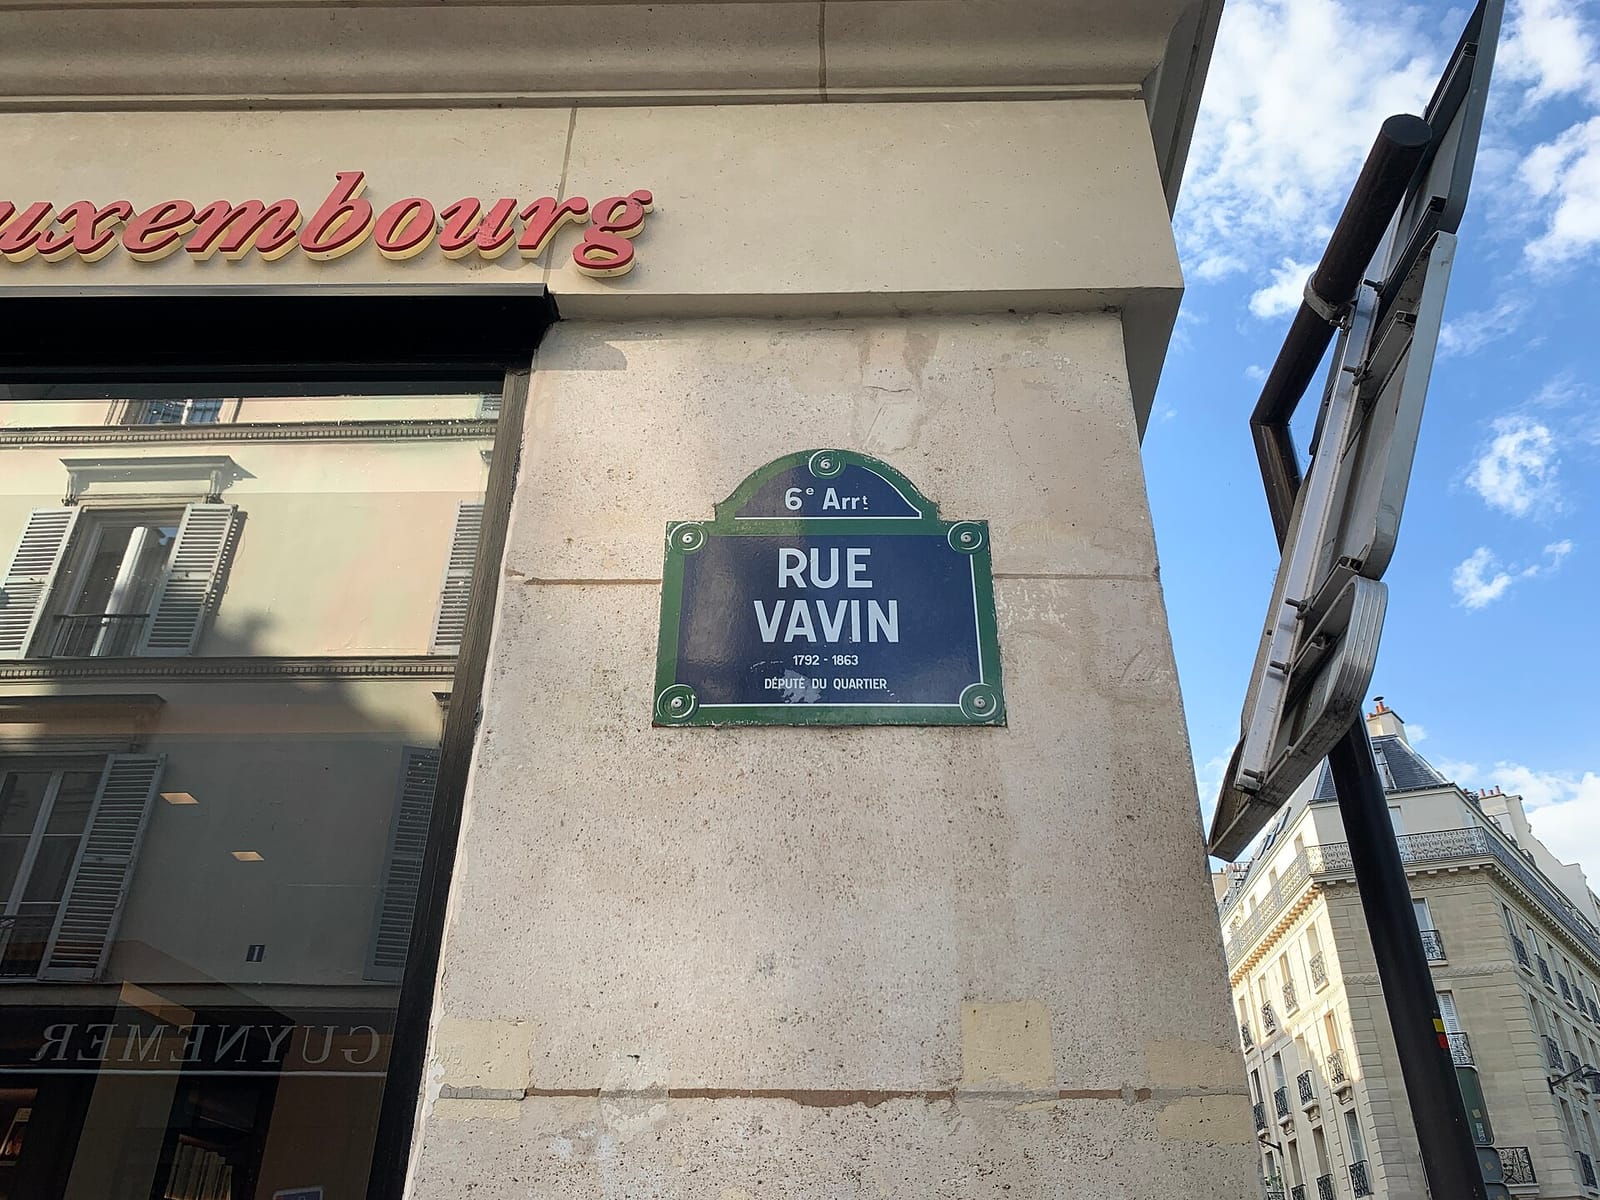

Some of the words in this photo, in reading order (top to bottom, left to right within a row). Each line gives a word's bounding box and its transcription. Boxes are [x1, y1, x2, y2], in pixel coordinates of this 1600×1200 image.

[0, 171, 654, 278] uxembourg
[777, 547, 873, 589] RUE
[753, 599, 900, 644] VAVIN
[792, 654, 820, 666] 1792
[831, 654, 859, 666] 1863
[764, 676, 806, 690] DÉPUTÉ
[812, 678, 827, 690] DU
[833, 678, 888, 690] QUARTIER
